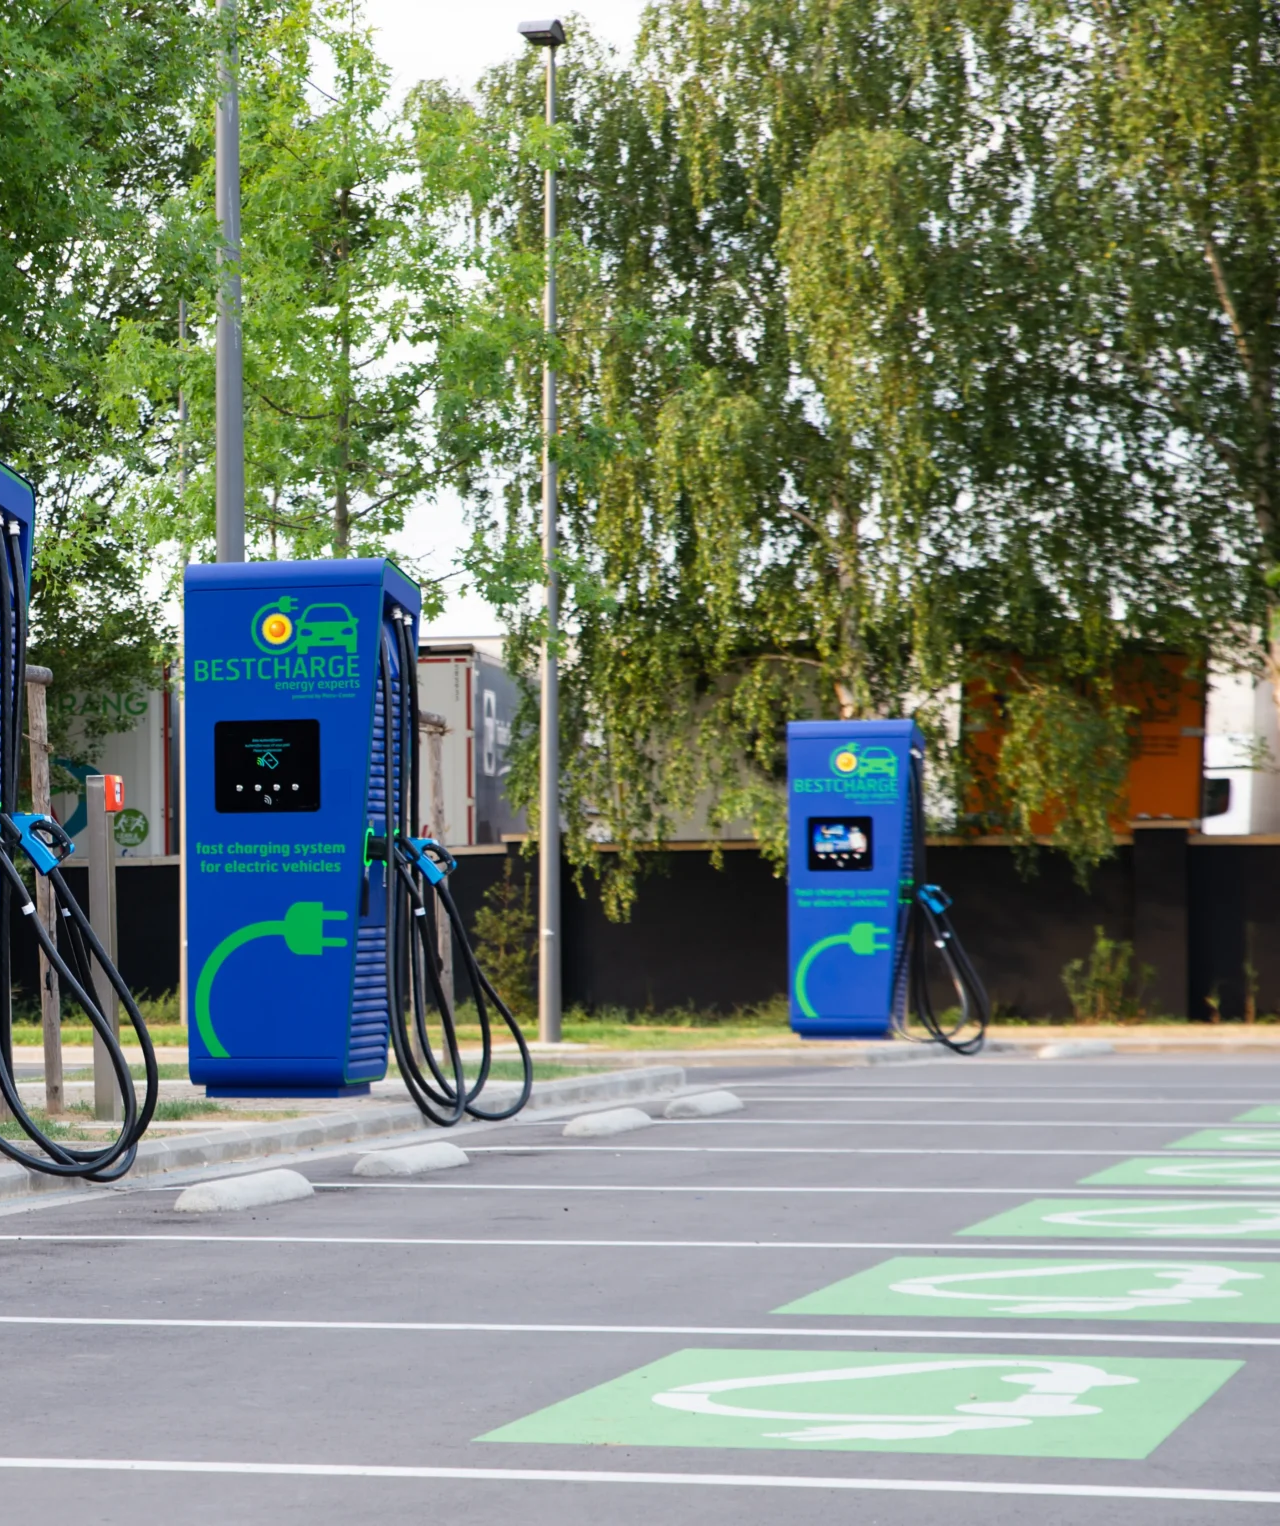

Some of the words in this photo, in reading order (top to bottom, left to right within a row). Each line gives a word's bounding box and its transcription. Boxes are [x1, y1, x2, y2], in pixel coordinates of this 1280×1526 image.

[194, 655, 360, 682] BESTCHARGE
[274, 681, 315, 693] energy
[317, 678, 361, 691] experts
[793, 778, 898, 793] BESTCHARGE
[196, 842, 223, 855] fast
[227, 842, 291, 857] charging
[294, 842, 346, 857] system
[200, 861, 222, 873] for
[224, 860, 279, 873] electric
[282, 860, 341, 873] vehicles
